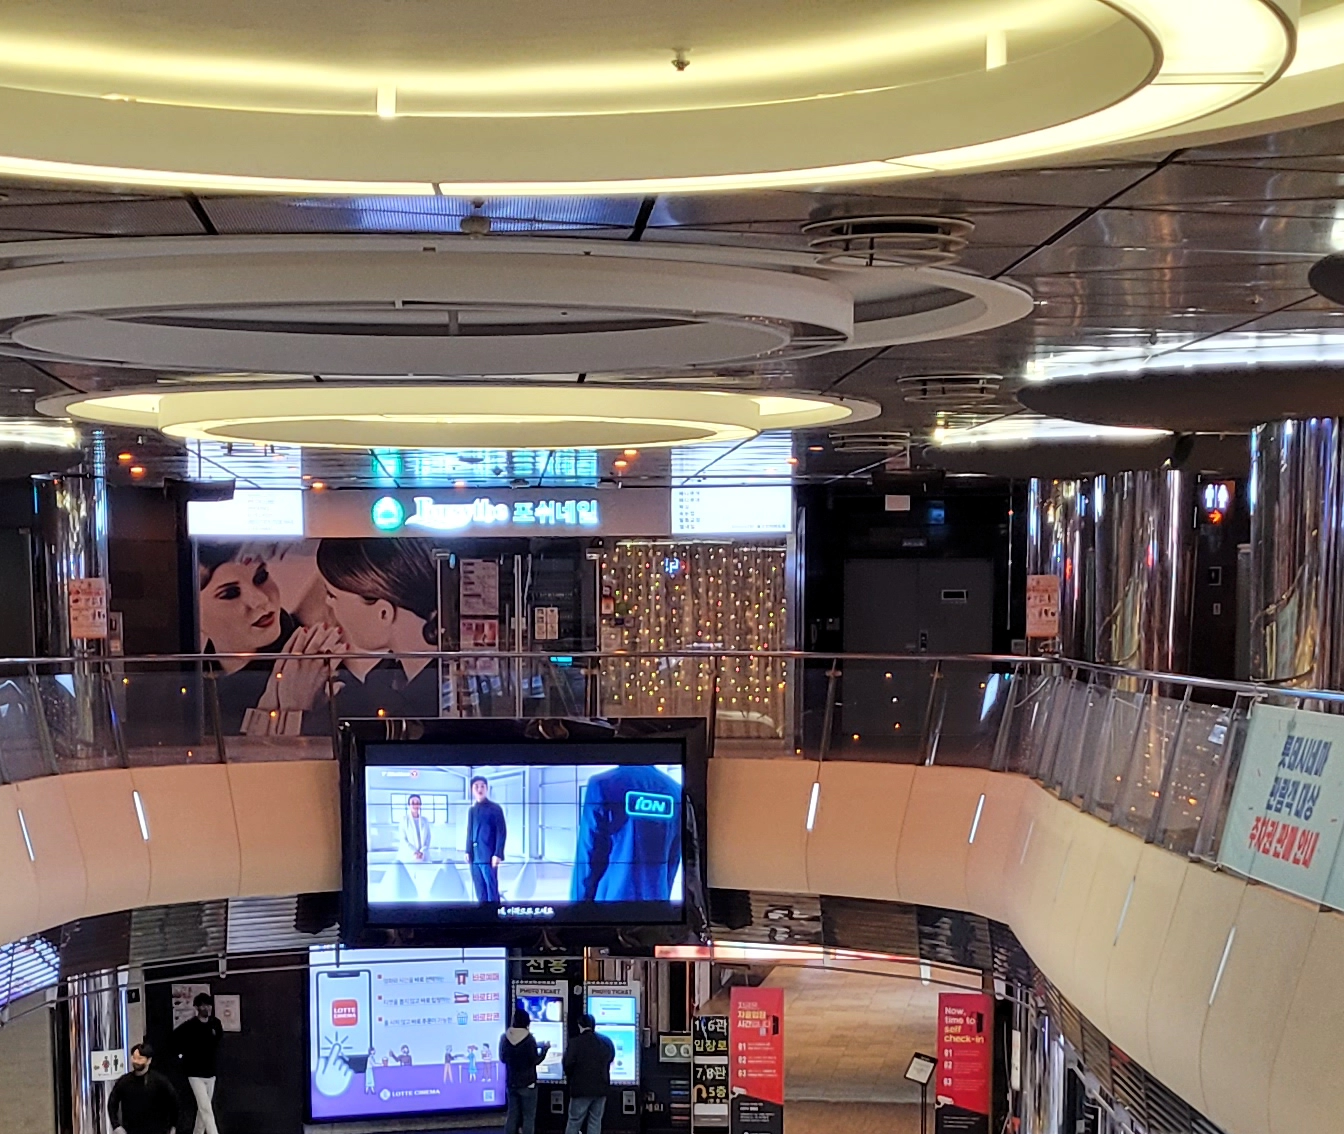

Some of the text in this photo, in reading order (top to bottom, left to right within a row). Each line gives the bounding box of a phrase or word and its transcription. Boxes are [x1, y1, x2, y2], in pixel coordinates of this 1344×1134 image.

[512, 499, 599, 526] 포쉬네일
[1277, 735, 1333, 778] 롯데시네마
[1265, 776, 1321, 821] 관람객 대상
[1248, 816, 1321, 869] 주차권 판매 안내
[944, 1016, 976, 1025] time to
[944, 1025, 962, 1034] self
[694, 1039, 728, 1052] 입장로
[944, 1034, 984, 1044] check-in
[392, 1088, 441, 1098] LOTTE CINEMA
